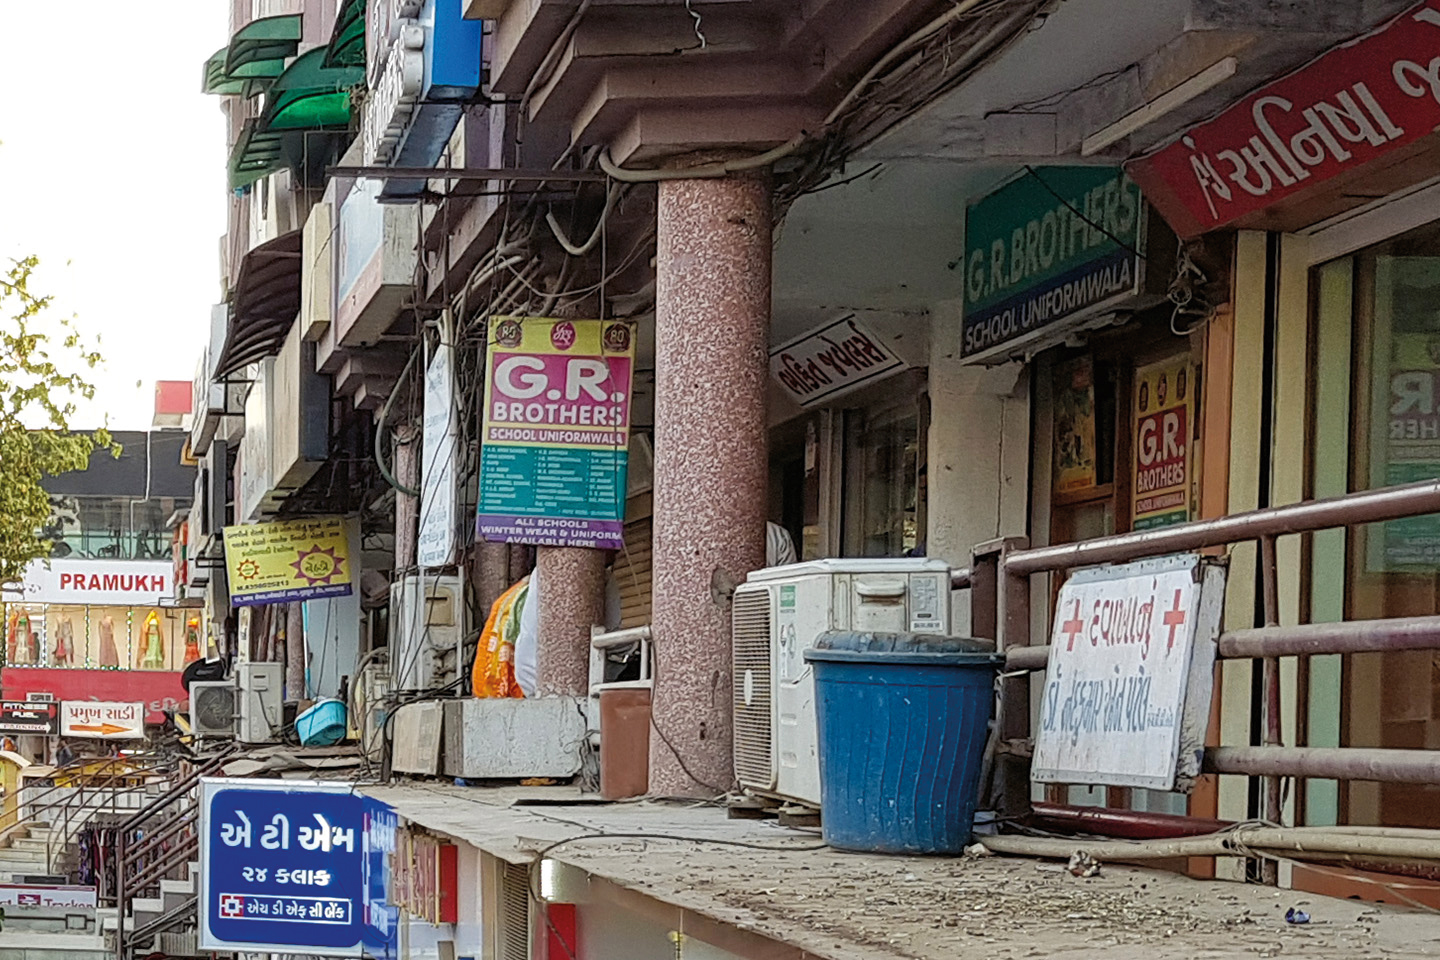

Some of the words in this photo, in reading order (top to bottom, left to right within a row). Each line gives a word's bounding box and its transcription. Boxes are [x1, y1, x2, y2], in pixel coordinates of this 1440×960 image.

[965, 306, 1019, 351] SCHOOL
[1021, 257, 1132, 328] UNIFORMWALA
[494, 356, 625, 403] G.R.
[492, 401, 623, 426] BROTHERS
[490, 428, 536, 440] SCHOOL
[539, 431, 623, 444] UNIFORMWALA
[1139, 412, 1185, 466] G.R.
[1138, 462, 1184, 493] BROTHERS
[481, 526, 523, 536] WINTER
[526, 528, 557, 537] WEAR
[571, 530, 621, 541] UNIFORM
[515, 518, 535, 527] ALL
[537, 519, 588, 529] SCHOOLS
[506, 536, 565, 546] AVAILABLE
[567, 539, 597, 548] HERE
[60, 573, 164, 592] PRAMUKH
[106, 705, 135, 720] સાડી
[220, 810, 252, 848] એ
[260, 813, 290, 850] ટી
[298, 813, 354, 853] એમ
[242, 866, 267, 882] ૨૪
[275, 869, 331, 886] કલાક
